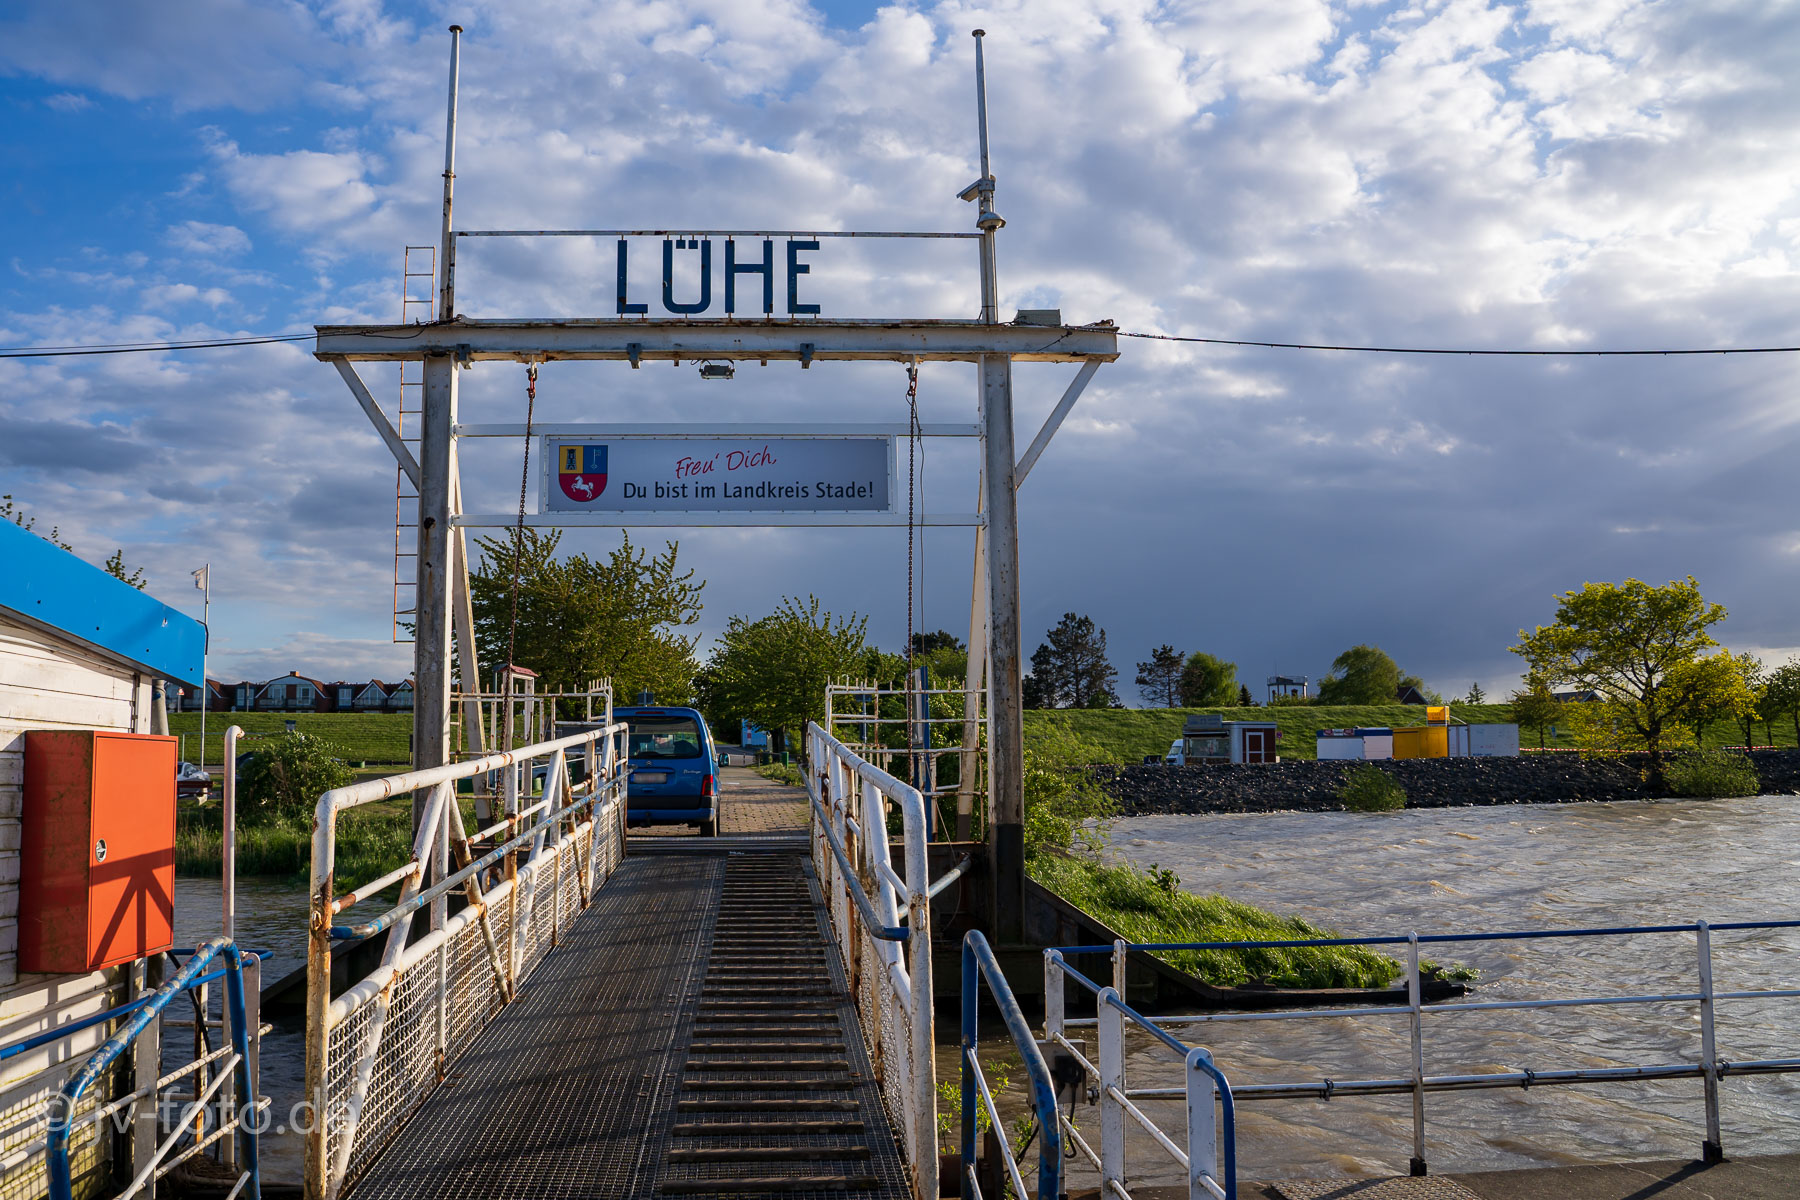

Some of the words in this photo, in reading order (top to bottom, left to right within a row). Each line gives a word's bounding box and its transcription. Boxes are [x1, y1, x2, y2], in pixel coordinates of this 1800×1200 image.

[616, 239, 821, 314] LÜHE
[725, 445, 777, 471] Dich,
[623, 482, 647, 498] Du
[654, 481, 688, 498] bist
[694, 481, 716, 498] im
[723, 481, 810, 498] Landkreis
[815, 481, 874, 498] Stade!
